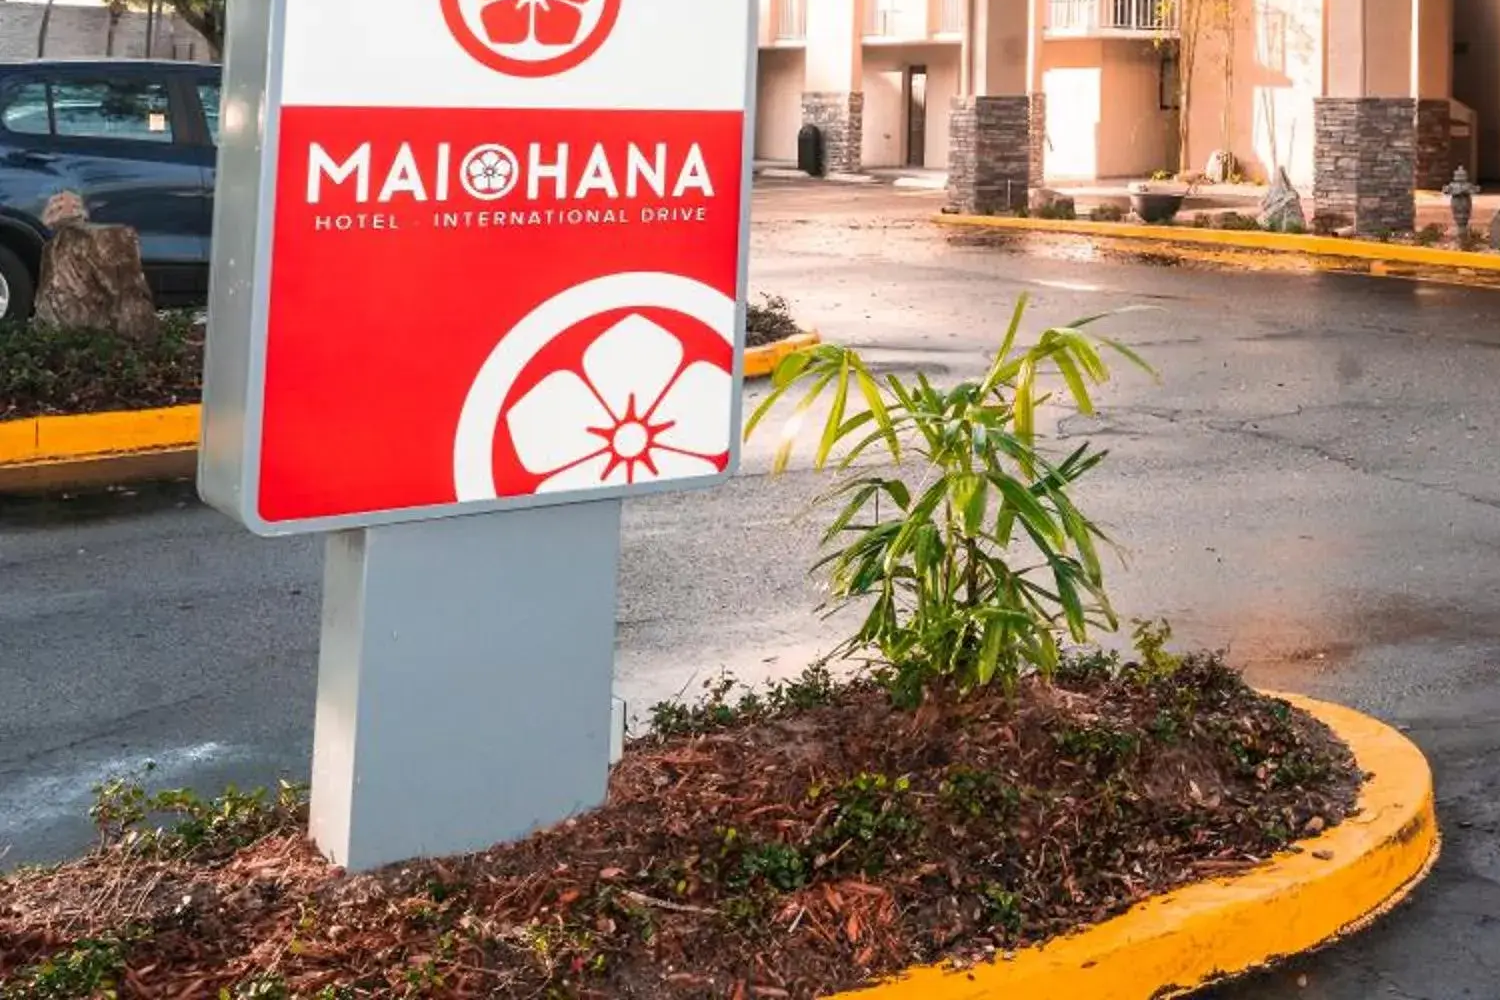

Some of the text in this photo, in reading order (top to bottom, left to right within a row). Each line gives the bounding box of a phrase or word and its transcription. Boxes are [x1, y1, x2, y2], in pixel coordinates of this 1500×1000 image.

[315, 206, 706, 230] HOTEL INTERNATIONAL DRIVE
